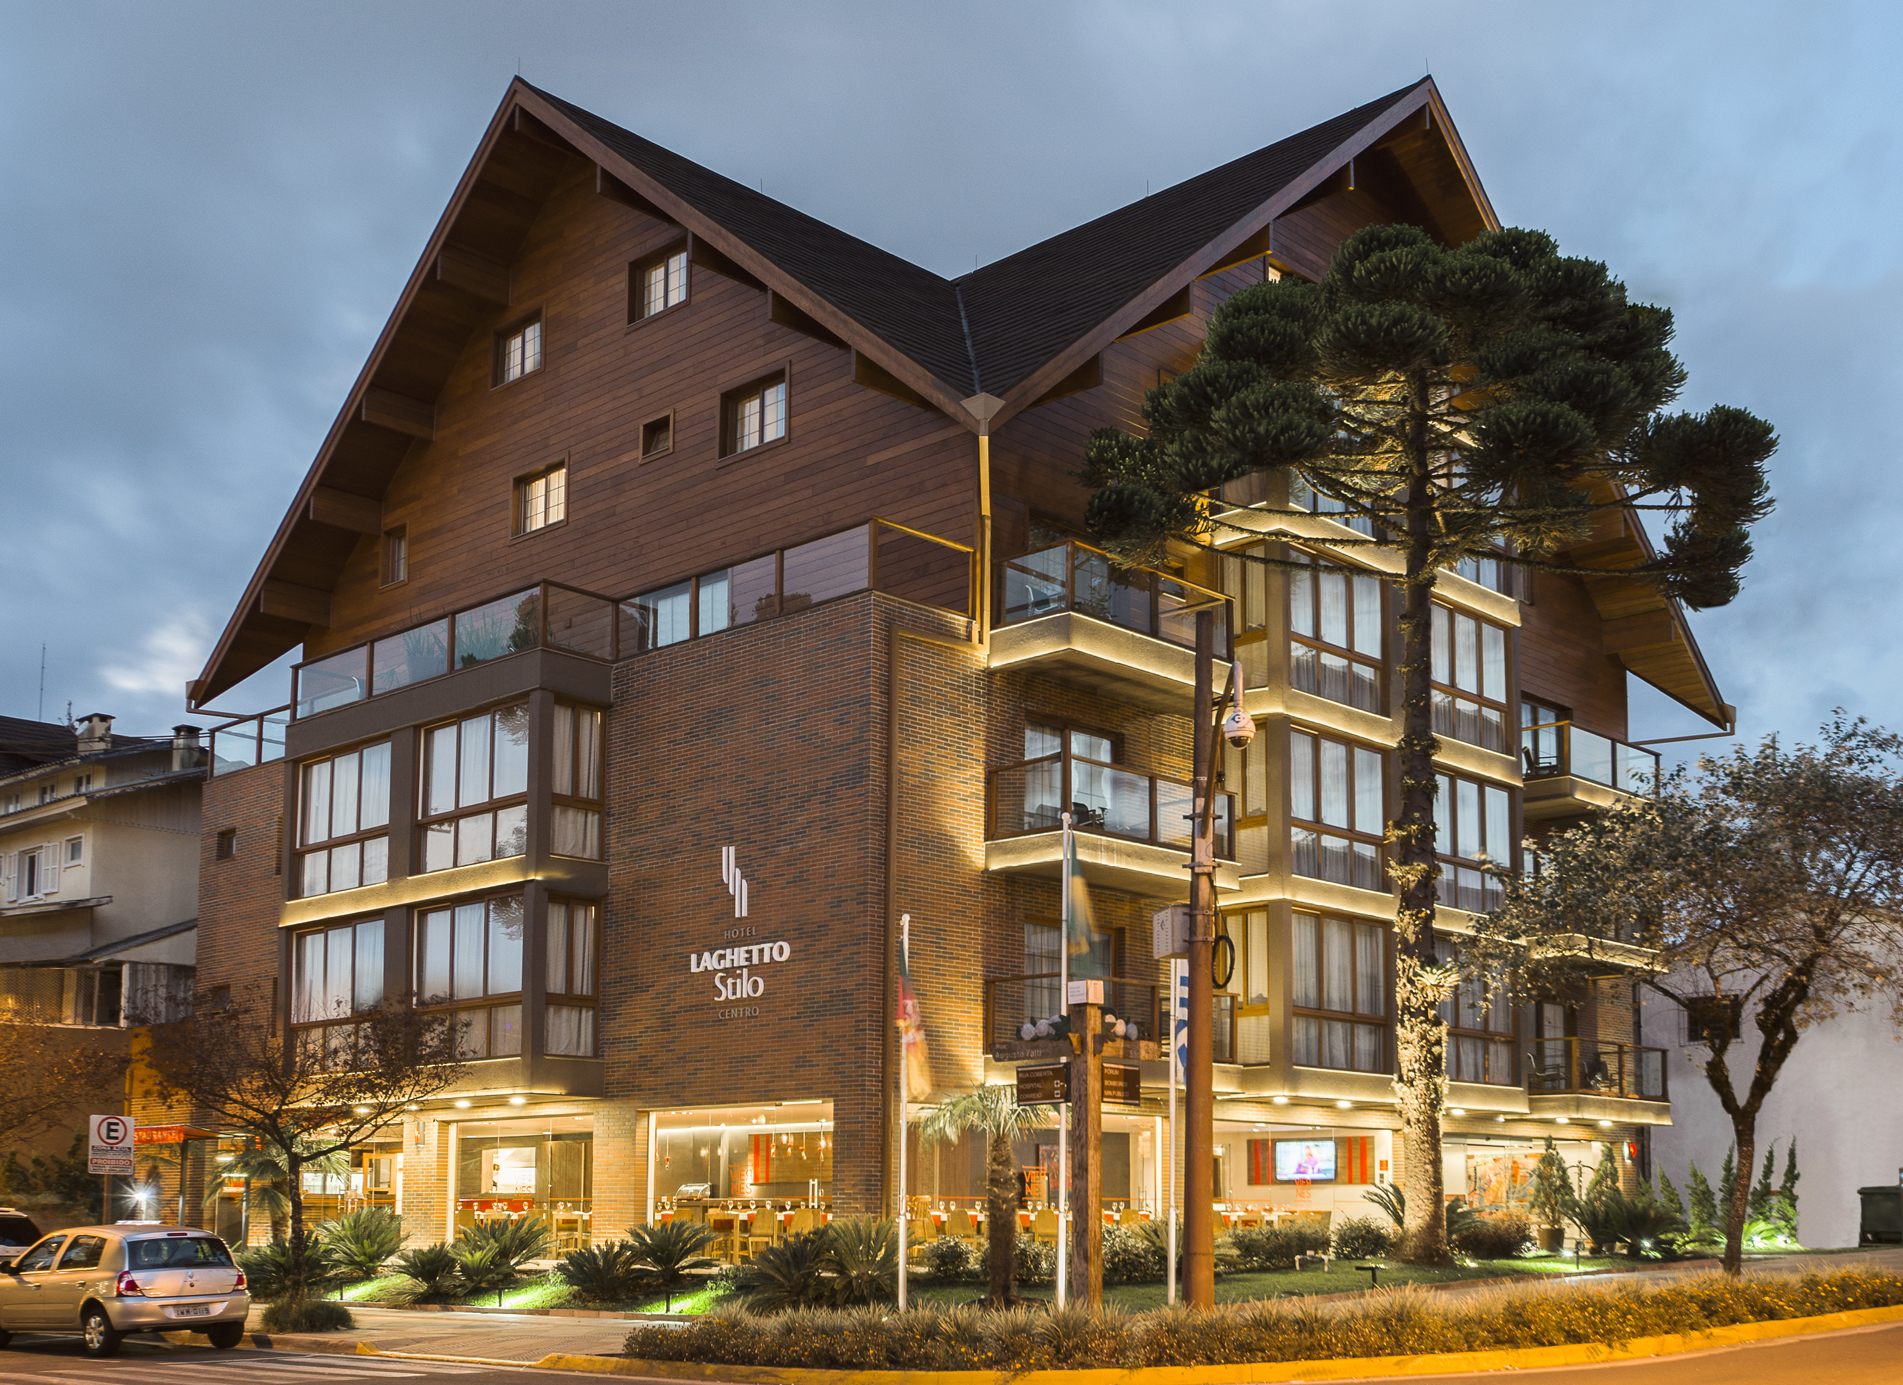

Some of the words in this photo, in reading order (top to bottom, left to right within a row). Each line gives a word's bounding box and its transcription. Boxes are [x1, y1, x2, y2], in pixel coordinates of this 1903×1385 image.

[724, 926, 757, 940] HOTEL
[690, 941, 791, 973] LAGHETTO
[714, 968, 765, 1001] Stilo
[718, 1006, 760, 1020] CENTRO
[995, 1050, 1025, 1061] Augusto
[1019, 1071, 1030, 1079] RUA
[1030, 1070, 1053, 1078] COBERTA
[1019, 1082, 1042, 1090] HOSPITAL
[1020, 1092, 1043, 1100] CORREIO
[106, 1121, 119, 1140] E
[133, 1130, 177, 1141] STAURANTE
[731, 1182, 752, 1195] NES
[1025, 1183, 1047, 1196] NES
